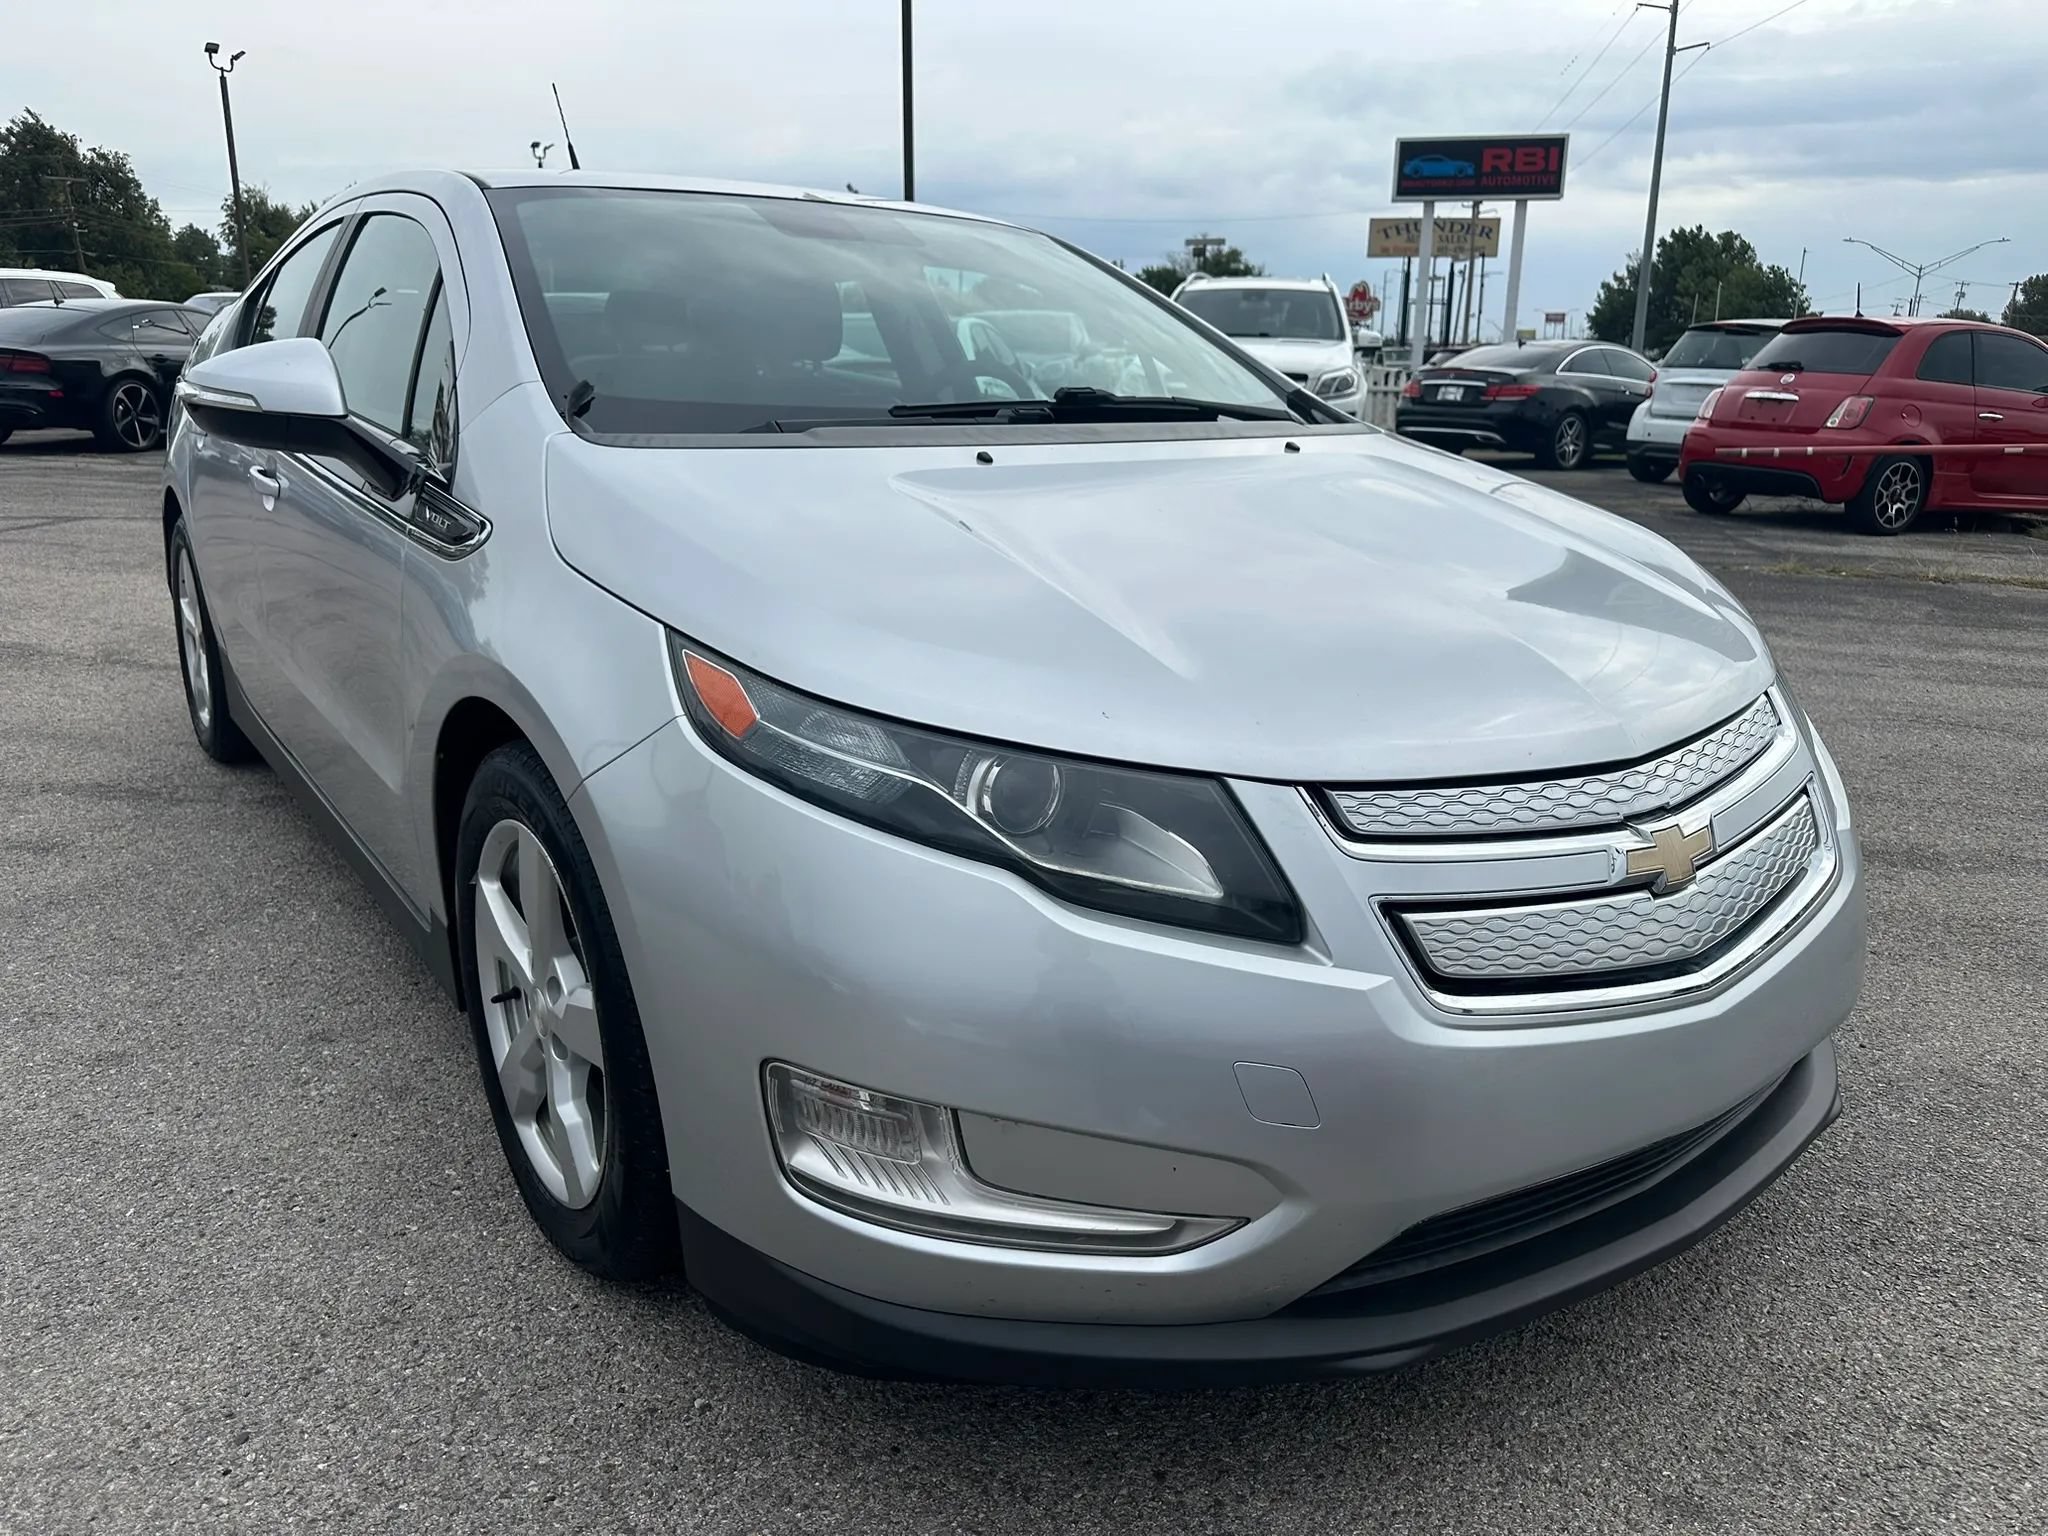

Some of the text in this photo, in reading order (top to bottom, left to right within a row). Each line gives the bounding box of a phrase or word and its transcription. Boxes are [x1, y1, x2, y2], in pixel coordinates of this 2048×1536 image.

[1481, 146, 1560, 173] RBI
[1480, 174, 1557, 187] AUTOMOTIVE
[425, 506, 451, 530] VOLT
